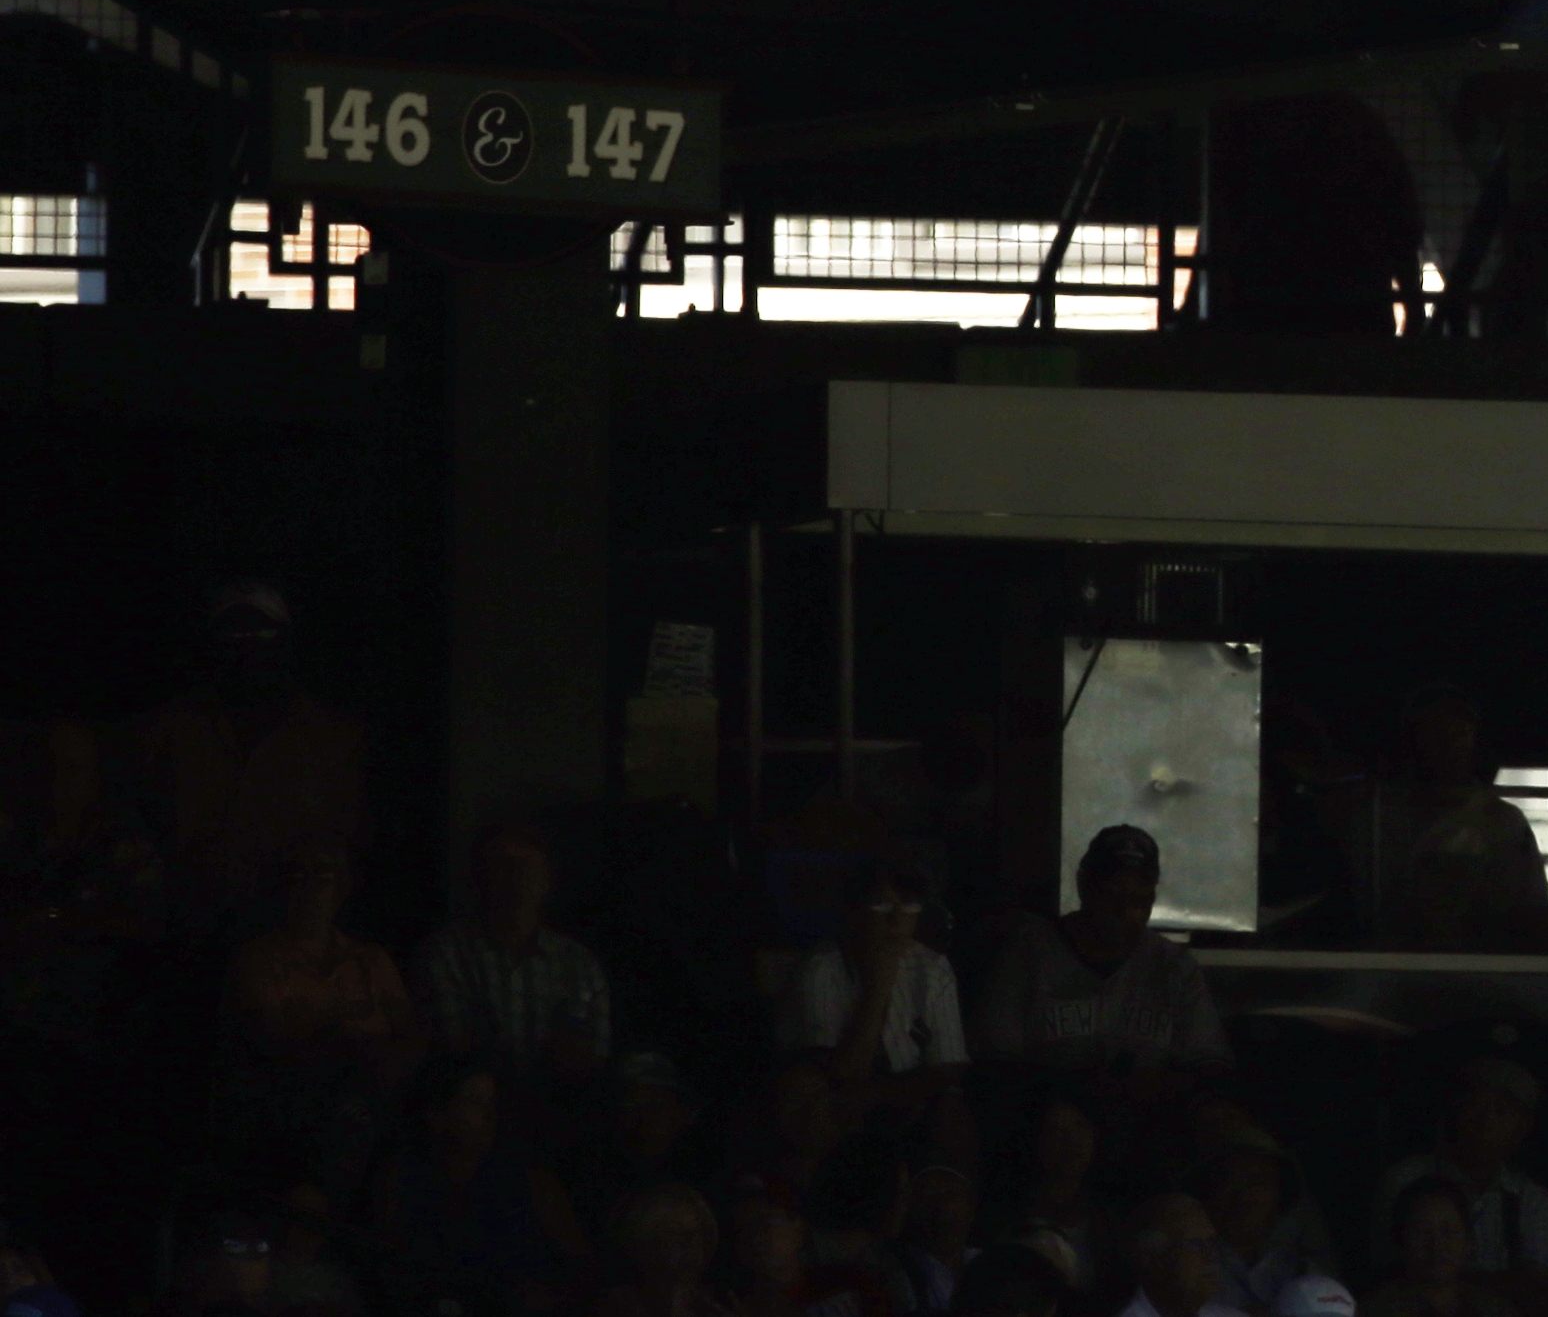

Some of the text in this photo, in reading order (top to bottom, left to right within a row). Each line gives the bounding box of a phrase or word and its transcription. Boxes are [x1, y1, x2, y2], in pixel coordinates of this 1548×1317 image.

[304, 85, 686, 183] 146 & 147
